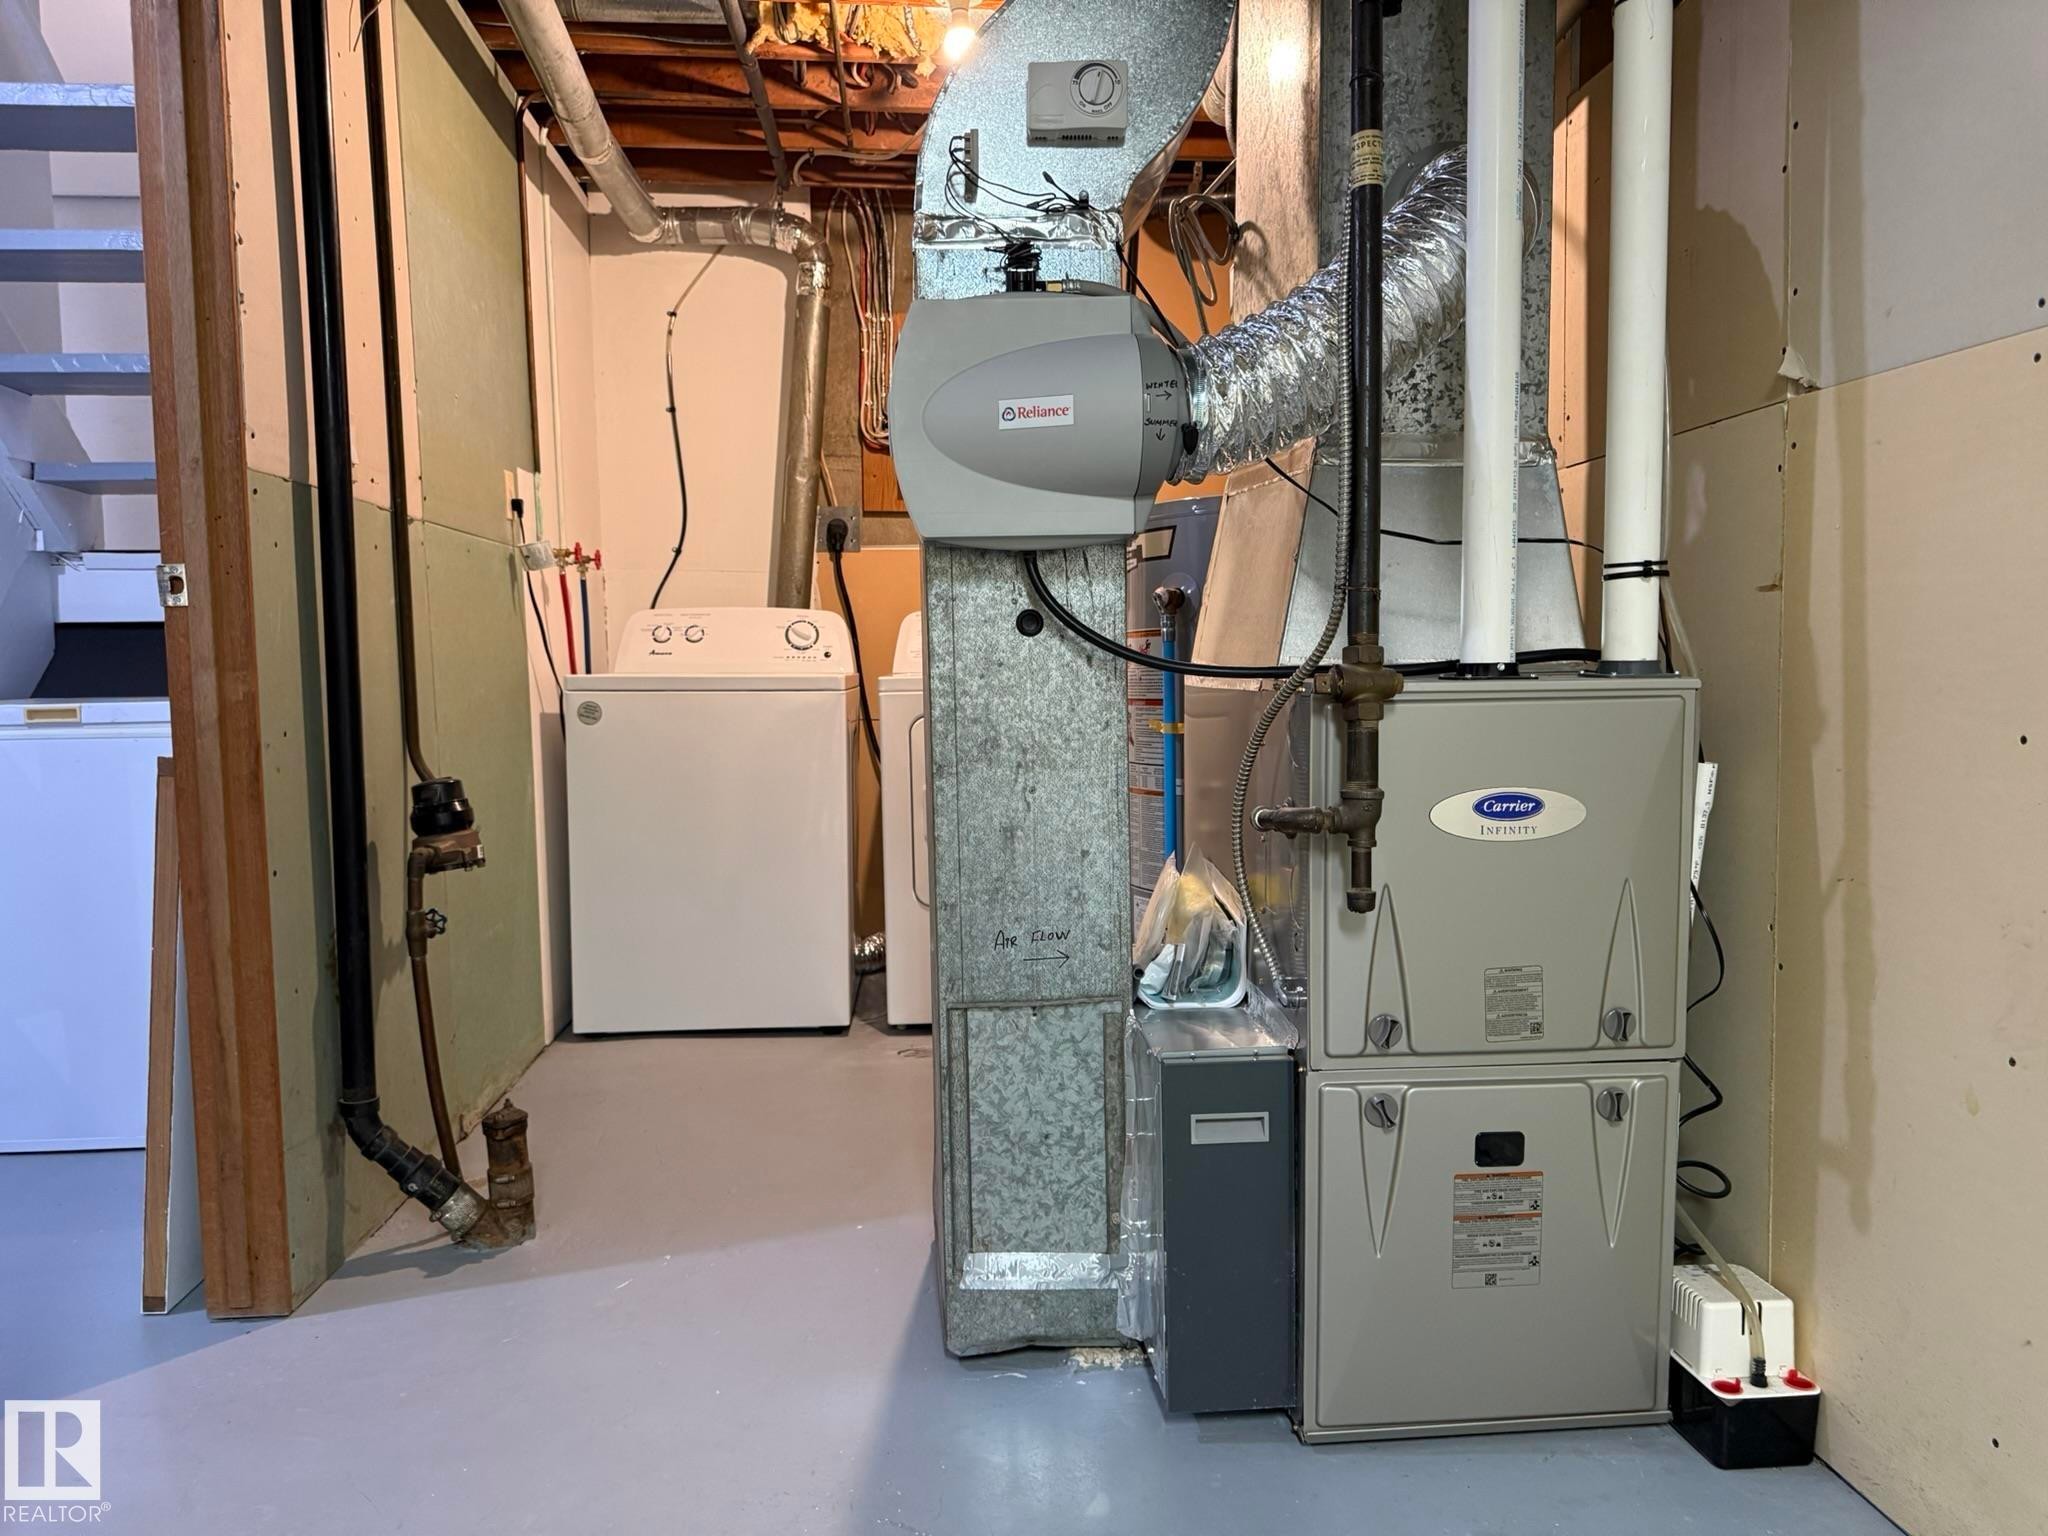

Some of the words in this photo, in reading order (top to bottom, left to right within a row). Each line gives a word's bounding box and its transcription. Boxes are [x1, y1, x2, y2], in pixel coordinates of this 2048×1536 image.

[1017, 406, 1070, 419] Reliance
[1483, 800, 1536, 813] Carrier
[1480, 825, 1538, 835] INFINITY
